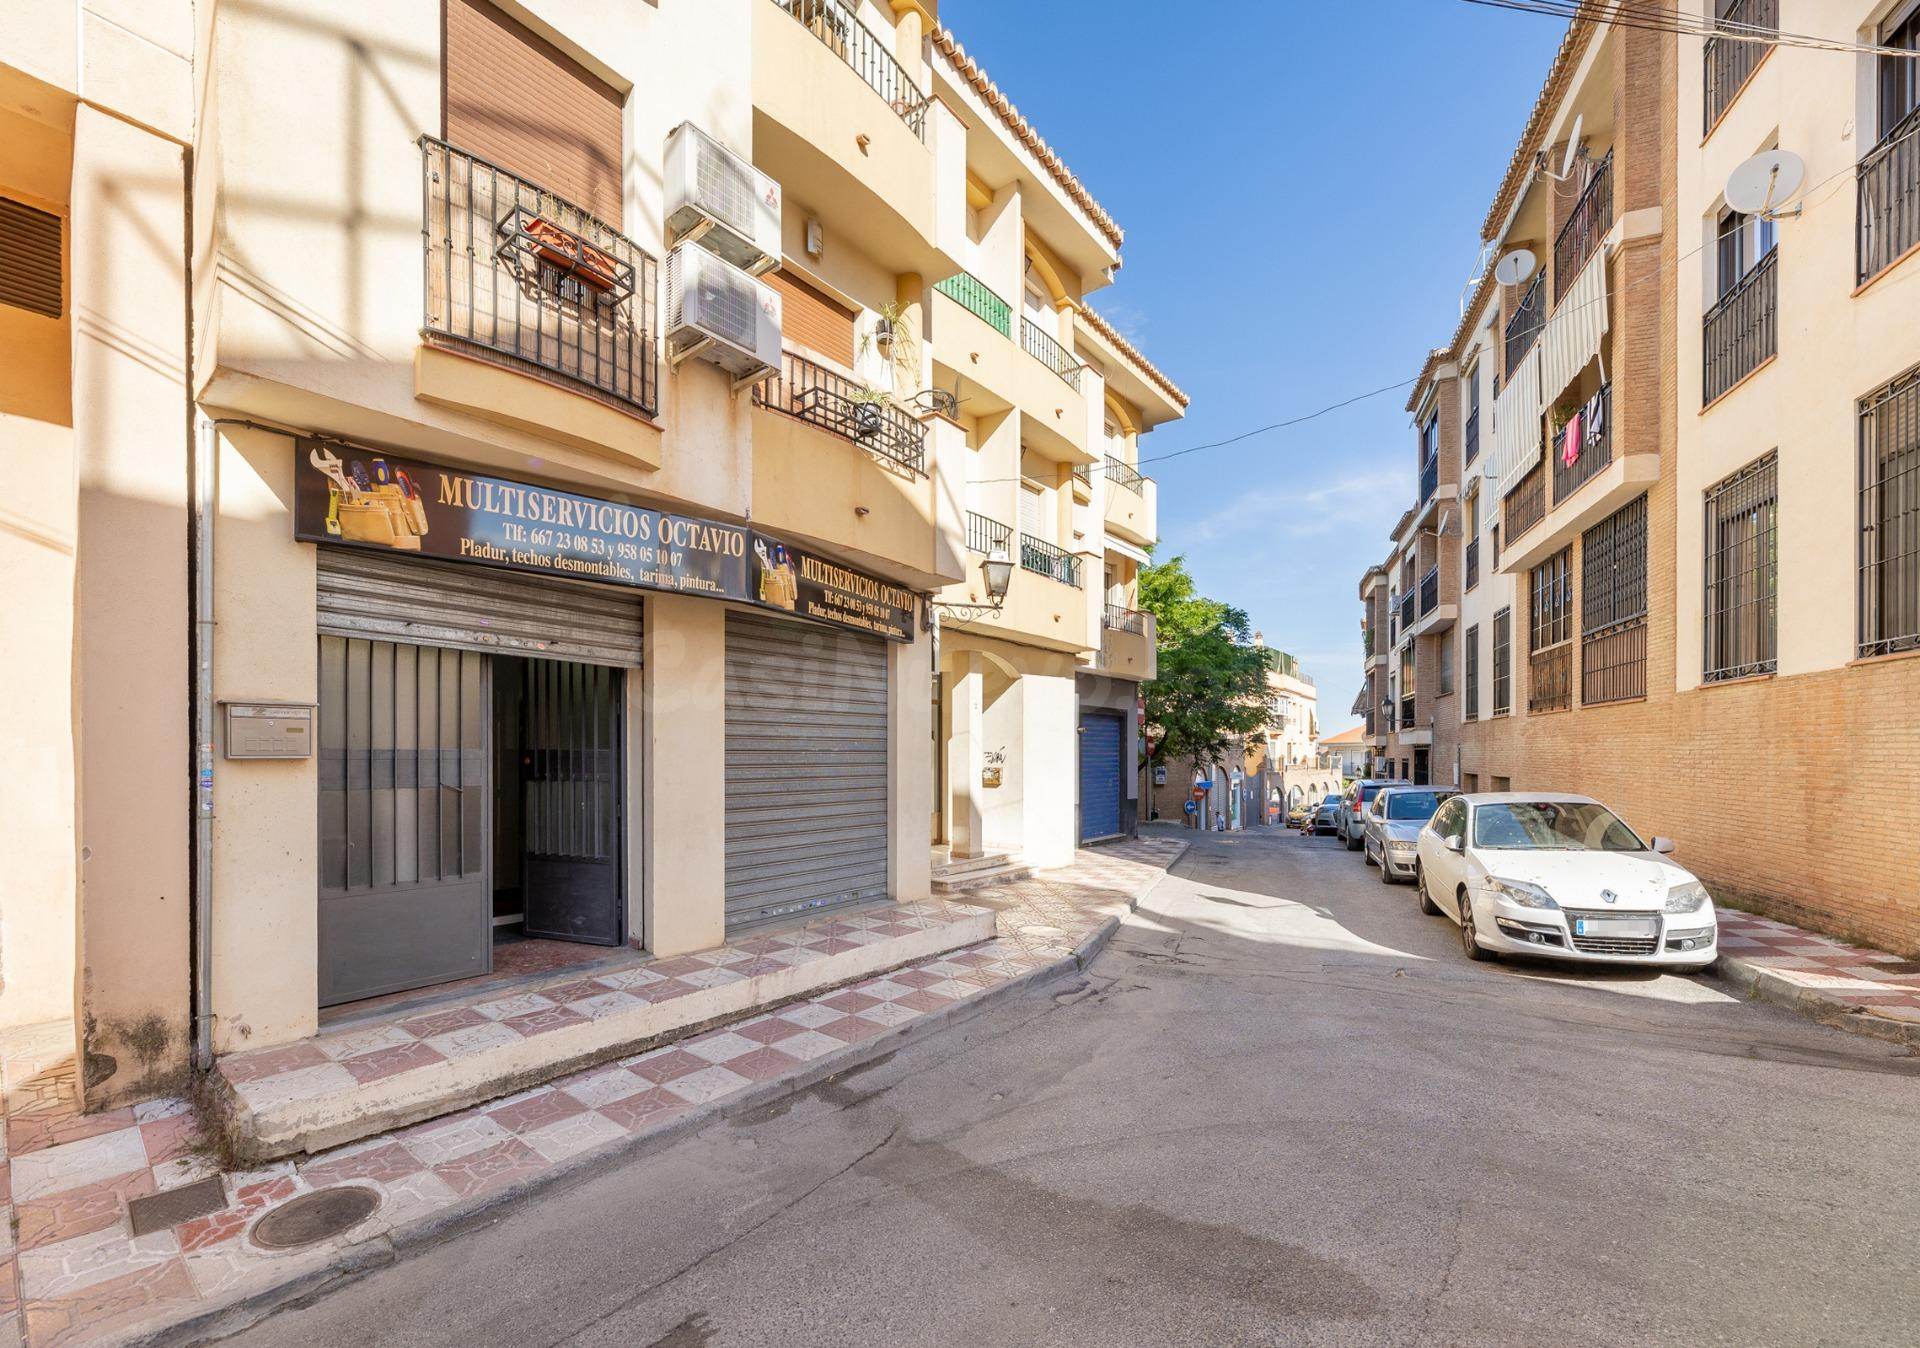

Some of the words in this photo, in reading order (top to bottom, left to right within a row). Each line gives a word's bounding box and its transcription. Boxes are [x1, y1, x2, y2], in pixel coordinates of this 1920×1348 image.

[438, 473, 651, 541] MULTISERVICIOS
[658, 517, 745, 558] OCTAVIO
[460, 538, 510, 564] Pladur,
[512, 548, 551, 568] techos
[554, 553, 635, 582] desmontables,
[639, 568, 678, 589] tarima,
[680, 574, 725, 593] pintura...
[502, 522, 527, 543] Tlf:
[531, 528, 553, 546] 667
[556, 532, 571, 550] 23
[574, 535, 588, 553] 08
[591, 538, 605, 555] 53
[607, 544, 615, 560] y
[617, 542, 637, 560] 958
[640, 546, 653, 563] 05
[656, 549, 668, 565] 10
[670, 551, 683, 567] 07
[801, 555, 879, 601] MULTISERVICIOS
[880, 585, 913, 612] OCTAVIO
